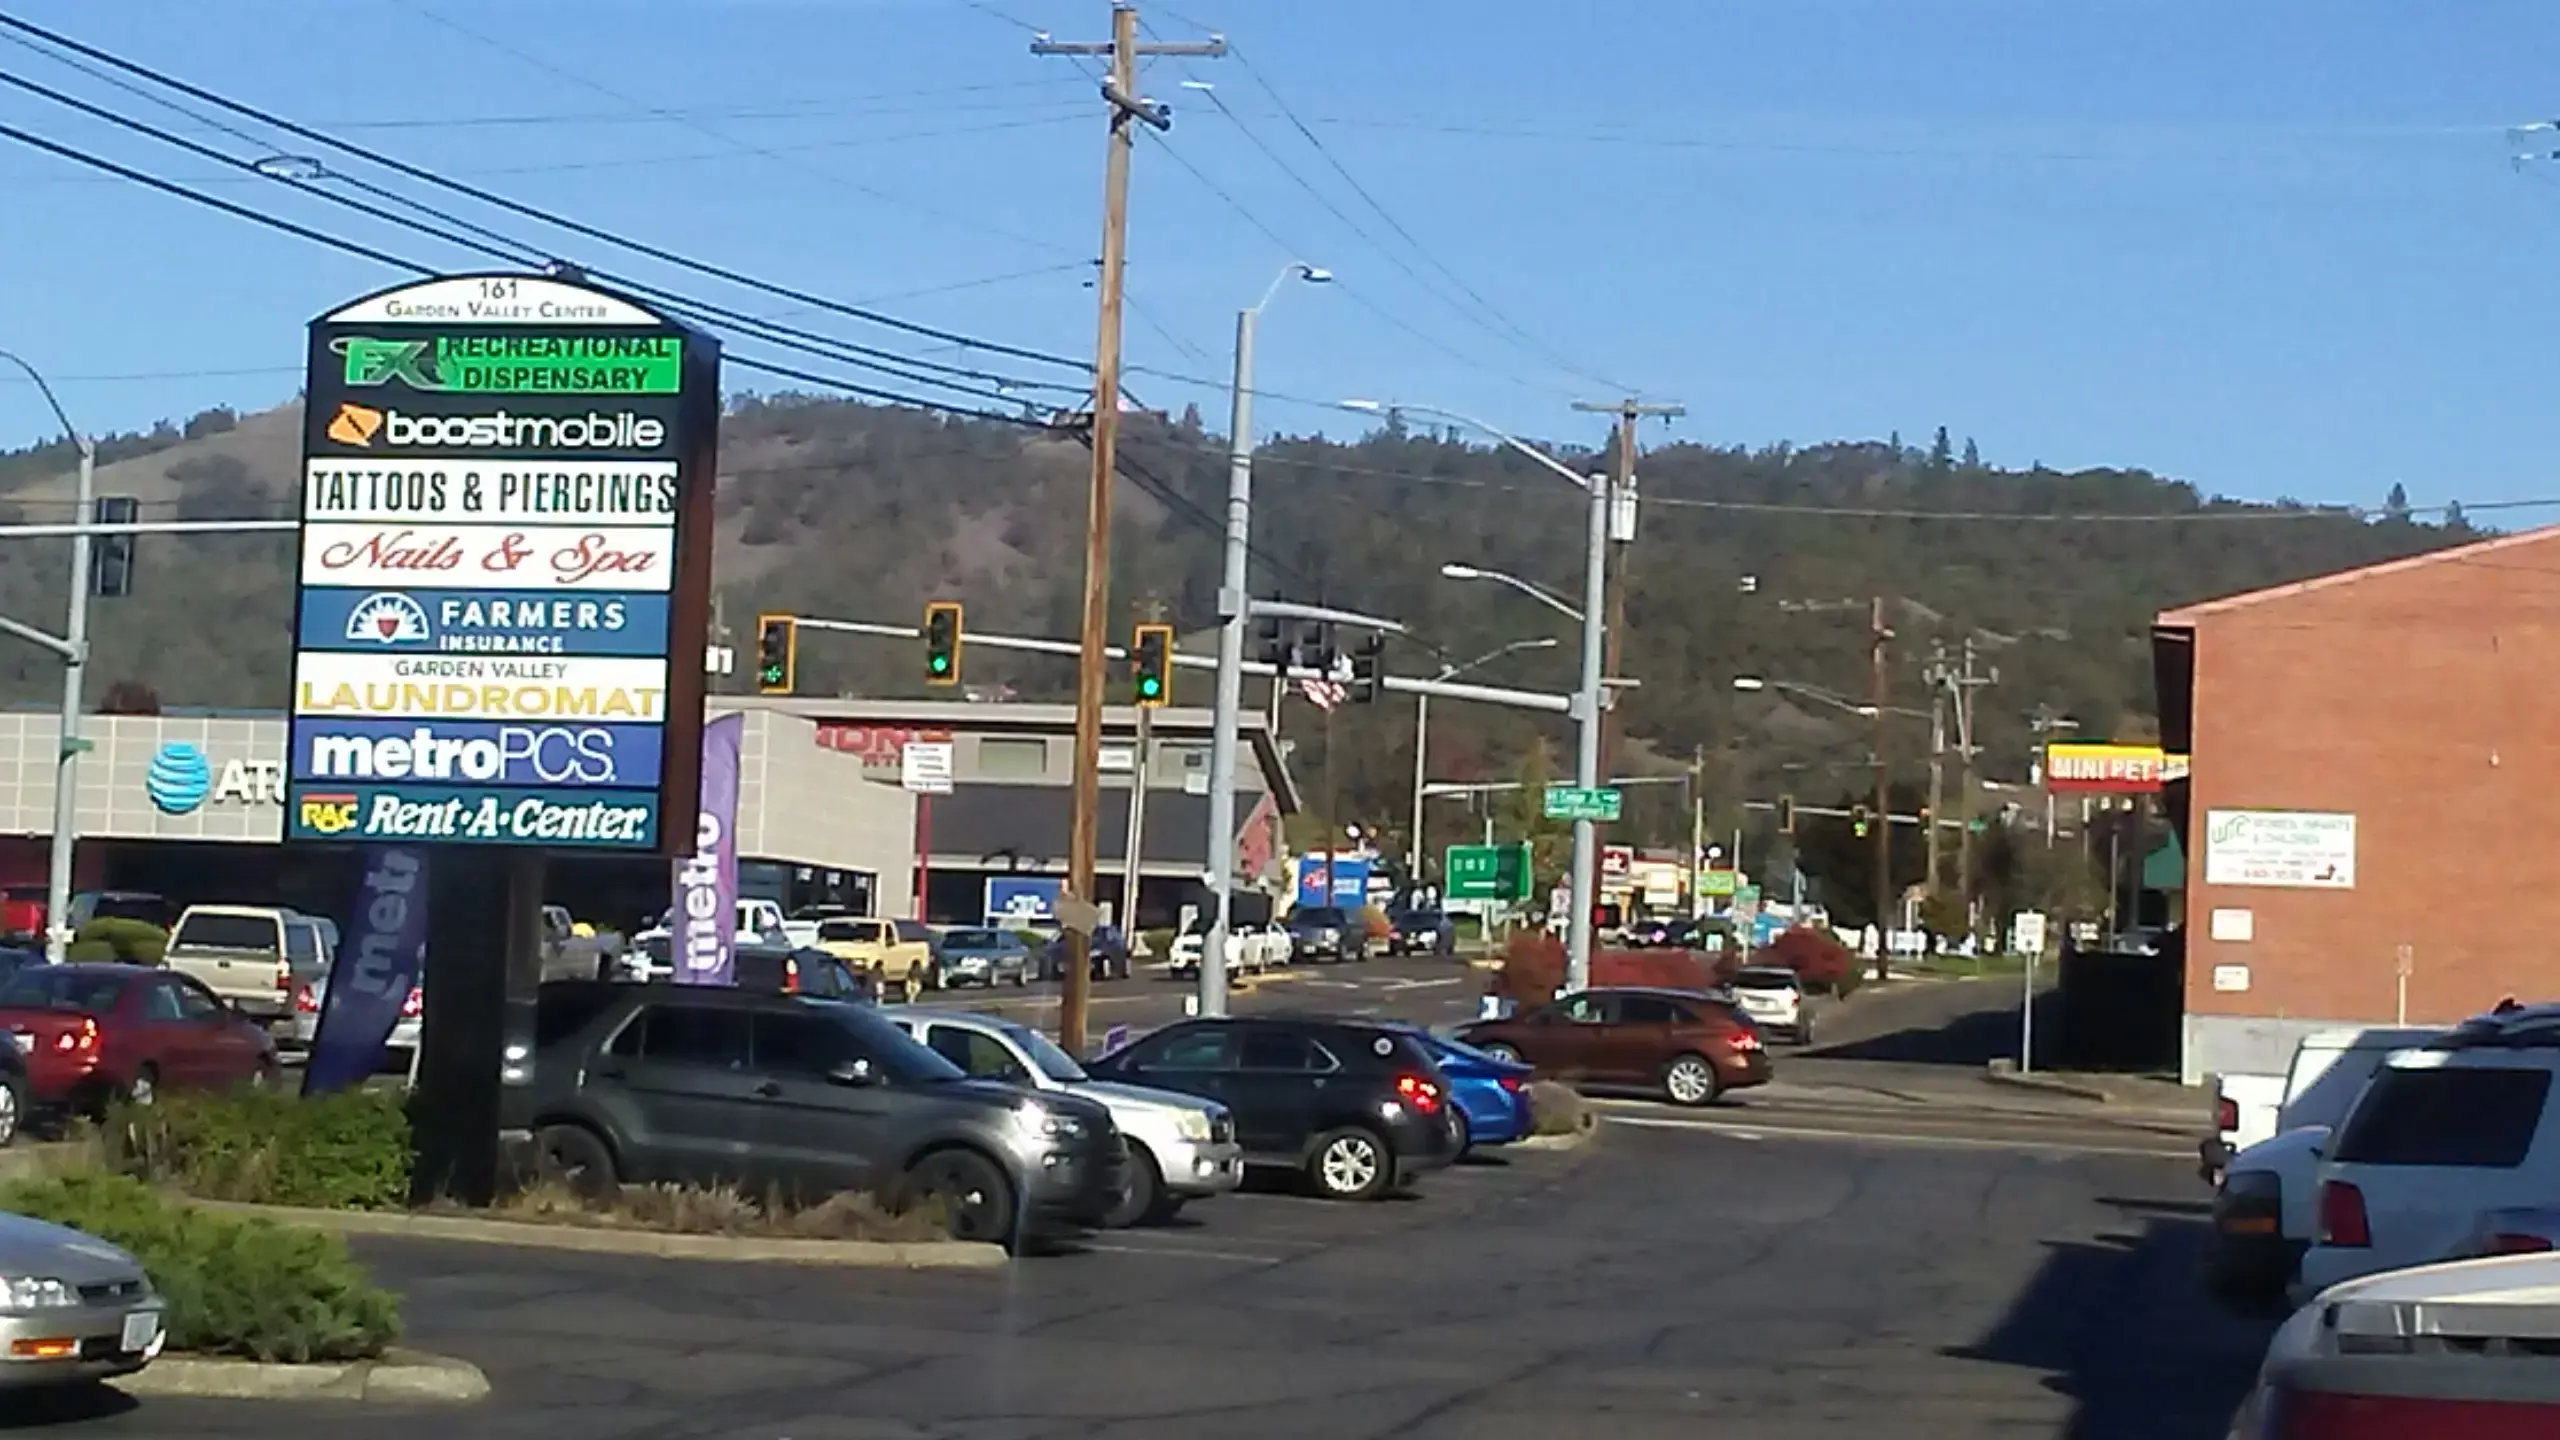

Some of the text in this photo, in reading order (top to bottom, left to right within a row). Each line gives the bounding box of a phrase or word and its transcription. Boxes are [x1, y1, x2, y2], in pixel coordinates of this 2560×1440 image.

[479, 281, 518, 299] 161
[445, 336, 671, 358] RECREATIONAL
[463, 366, 649, 390] DISPENSARY
[313, 470, 678, 514] TATTOOS & PIERCINGS
[320, 530, 656, 585] Nails & Spa
[440, 600, 627, 630] FARMERS
[440, 635, 564, 653] INSURANCE
[395, 659, 568, 679] GARDEN VALLEY
[301, 681, 665, 718] LAUNDROMAT
[2052, 757, 2105, 780] MINI
[2110, 758, 2153, 782] PET
[679, 811, 729, 974] metro
